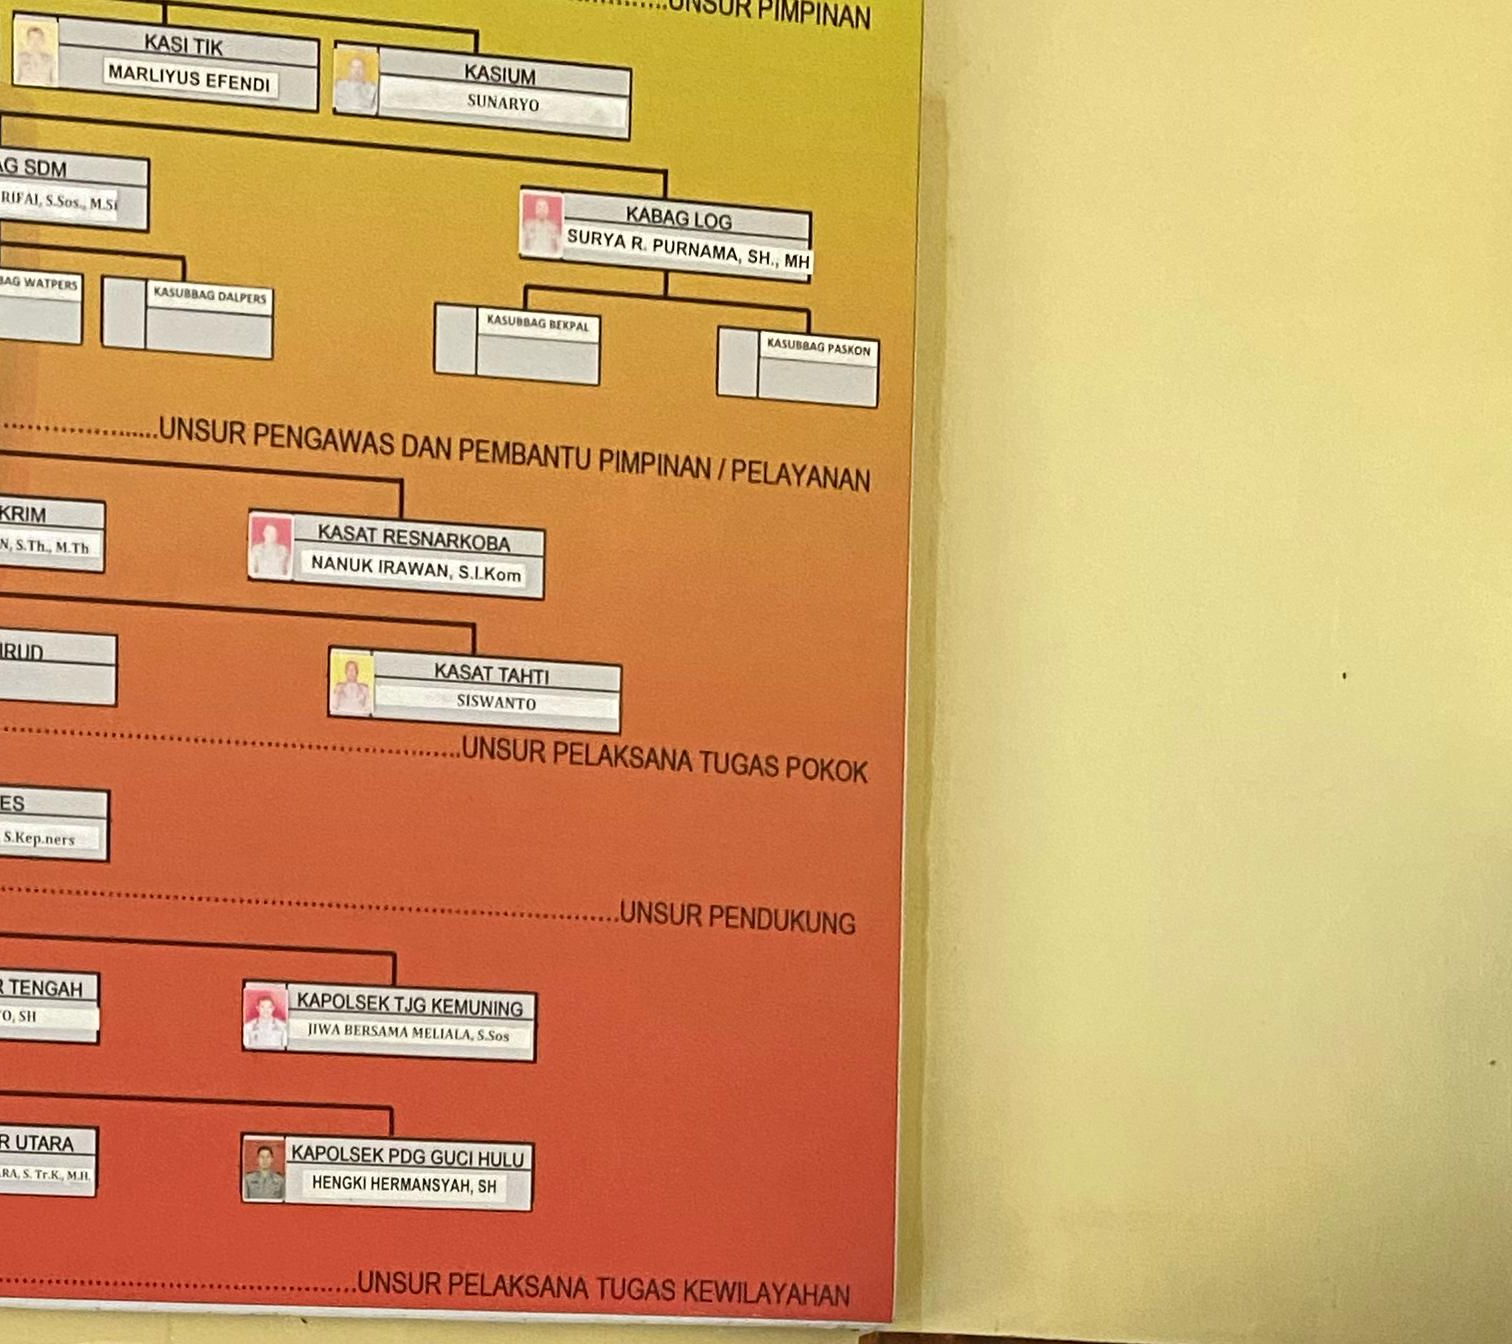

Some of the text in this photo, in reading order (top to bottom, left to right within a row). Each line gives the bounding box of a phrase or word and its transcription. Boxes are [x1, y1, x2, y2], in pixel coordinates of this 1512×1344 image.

[144, 33, 224, 55] KASI TIK
[108, 64, 270, 93] MARLIYUS EFENDI
[465, 64, 536, 85] KASIUM
[467, 94, 540, 113] SUNARYO
[24, 157, 68, 177] SDM
[626, 206, 733, 231] KABAG LOG
[568, 228, 626, 250] SURYA
[631, 234, 648, 251] R.
[653, 238, 742, 265] PURNAMA,
[784, 252, 810, 270] MH
[768, 338, 871, 356] KASUBBAG PASKON
[253, 424, 396, 457] PENGAWAS
[401, 434, 452, 461] DAN
[458, 438, 591, 470] PEMBANTU
[598, 448, 711, 481] PIMPINAN
[718, 458, 726, 481] /
[730, 460, 871, 492] PELAYANAN
[318, 524, 510, 552] KASAT RESNARKOBA
[311, 554, 522, 584] NANUK IRAWAN, S.I.Kom
[553, 742, 692, 772] PELAKSANA
[699, 749, 779, 778] TUGAS
[787, 755, 869, 784] POKOK
[709, 905, 856, 935] PENDUKUNG
[10, 978, 84, 998] TENGAH
[292, 1144, 525, 1167] KAPOLSEK PDG GUCI HULU
[312, 1174, 497, 1195] HENGKI HERMANSYAH, SH
[449, 1273, 588, 1300] PELAKSANA
[597, 1277, 676, 1302] TUGAS
[683, 1279, 850, 1307] KEWILAYAHAN
